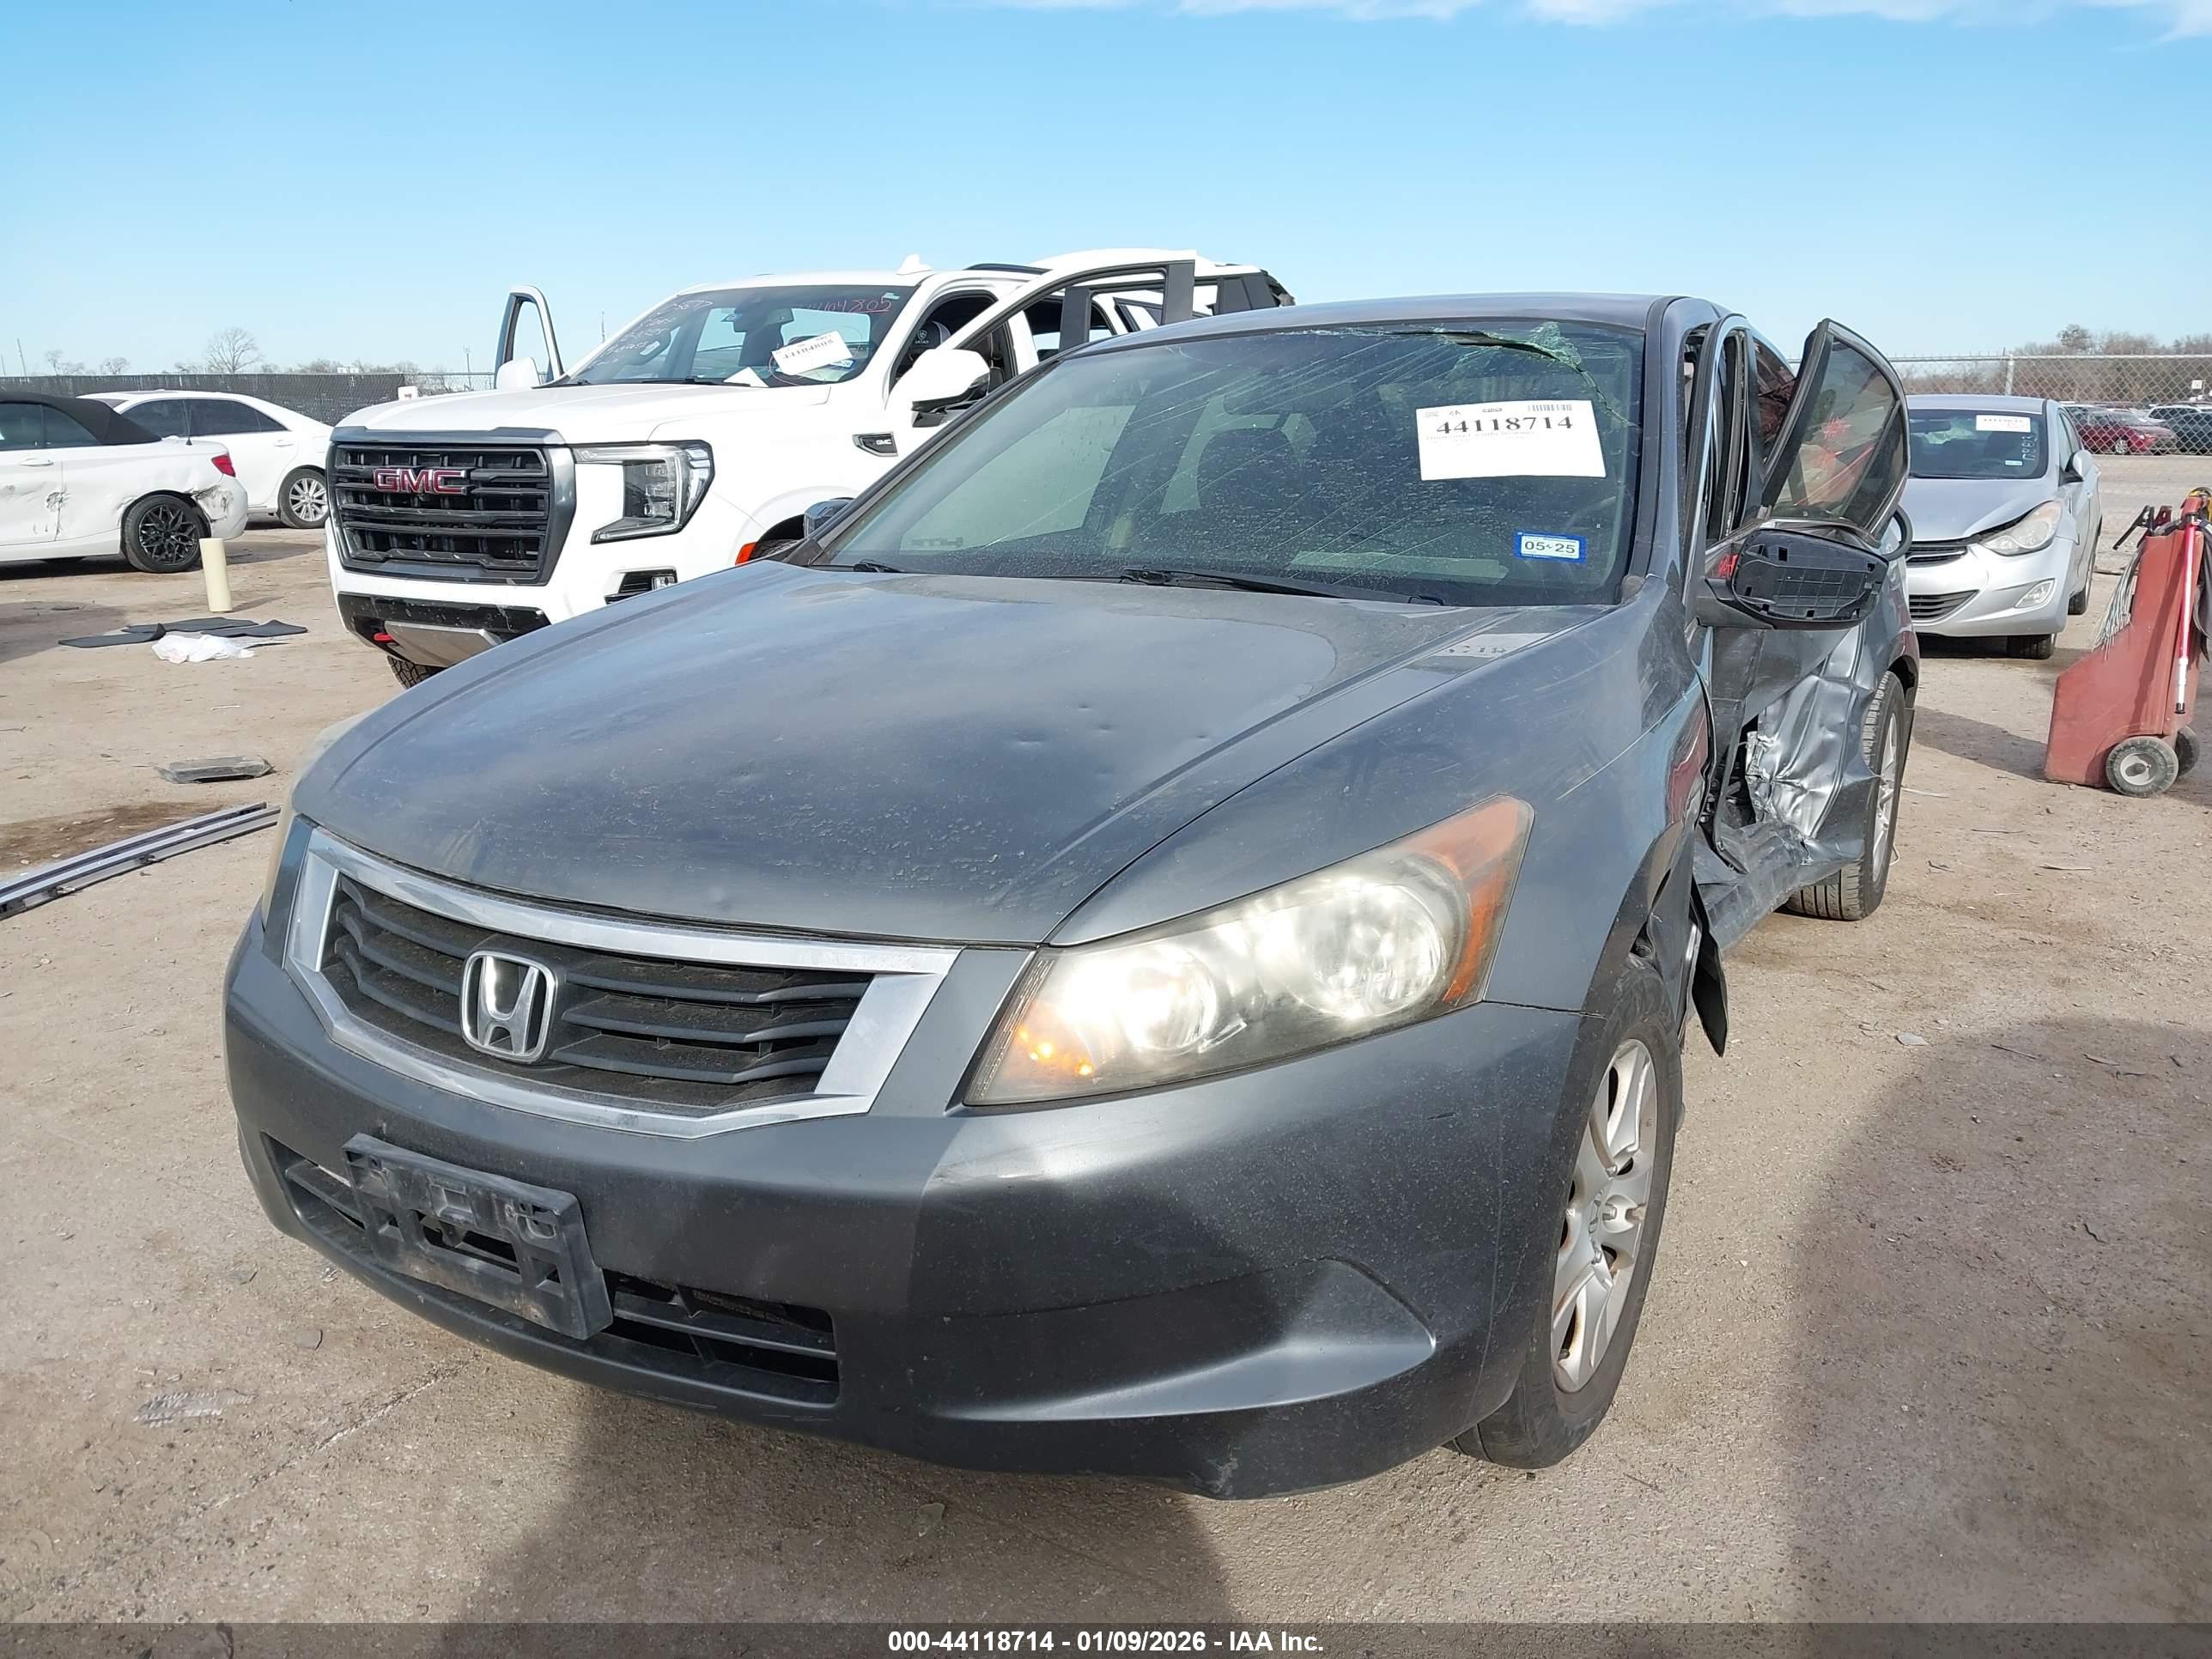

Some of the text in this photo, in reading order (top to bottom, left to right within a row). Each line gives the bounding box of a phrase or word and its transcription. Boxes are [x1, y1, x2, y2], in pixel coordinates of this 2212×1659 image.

[1436, 416, 1574, 434] 44118714
[374, 468, 467, 495] GMC
[1524, 541, 1576, 554] 05 25
